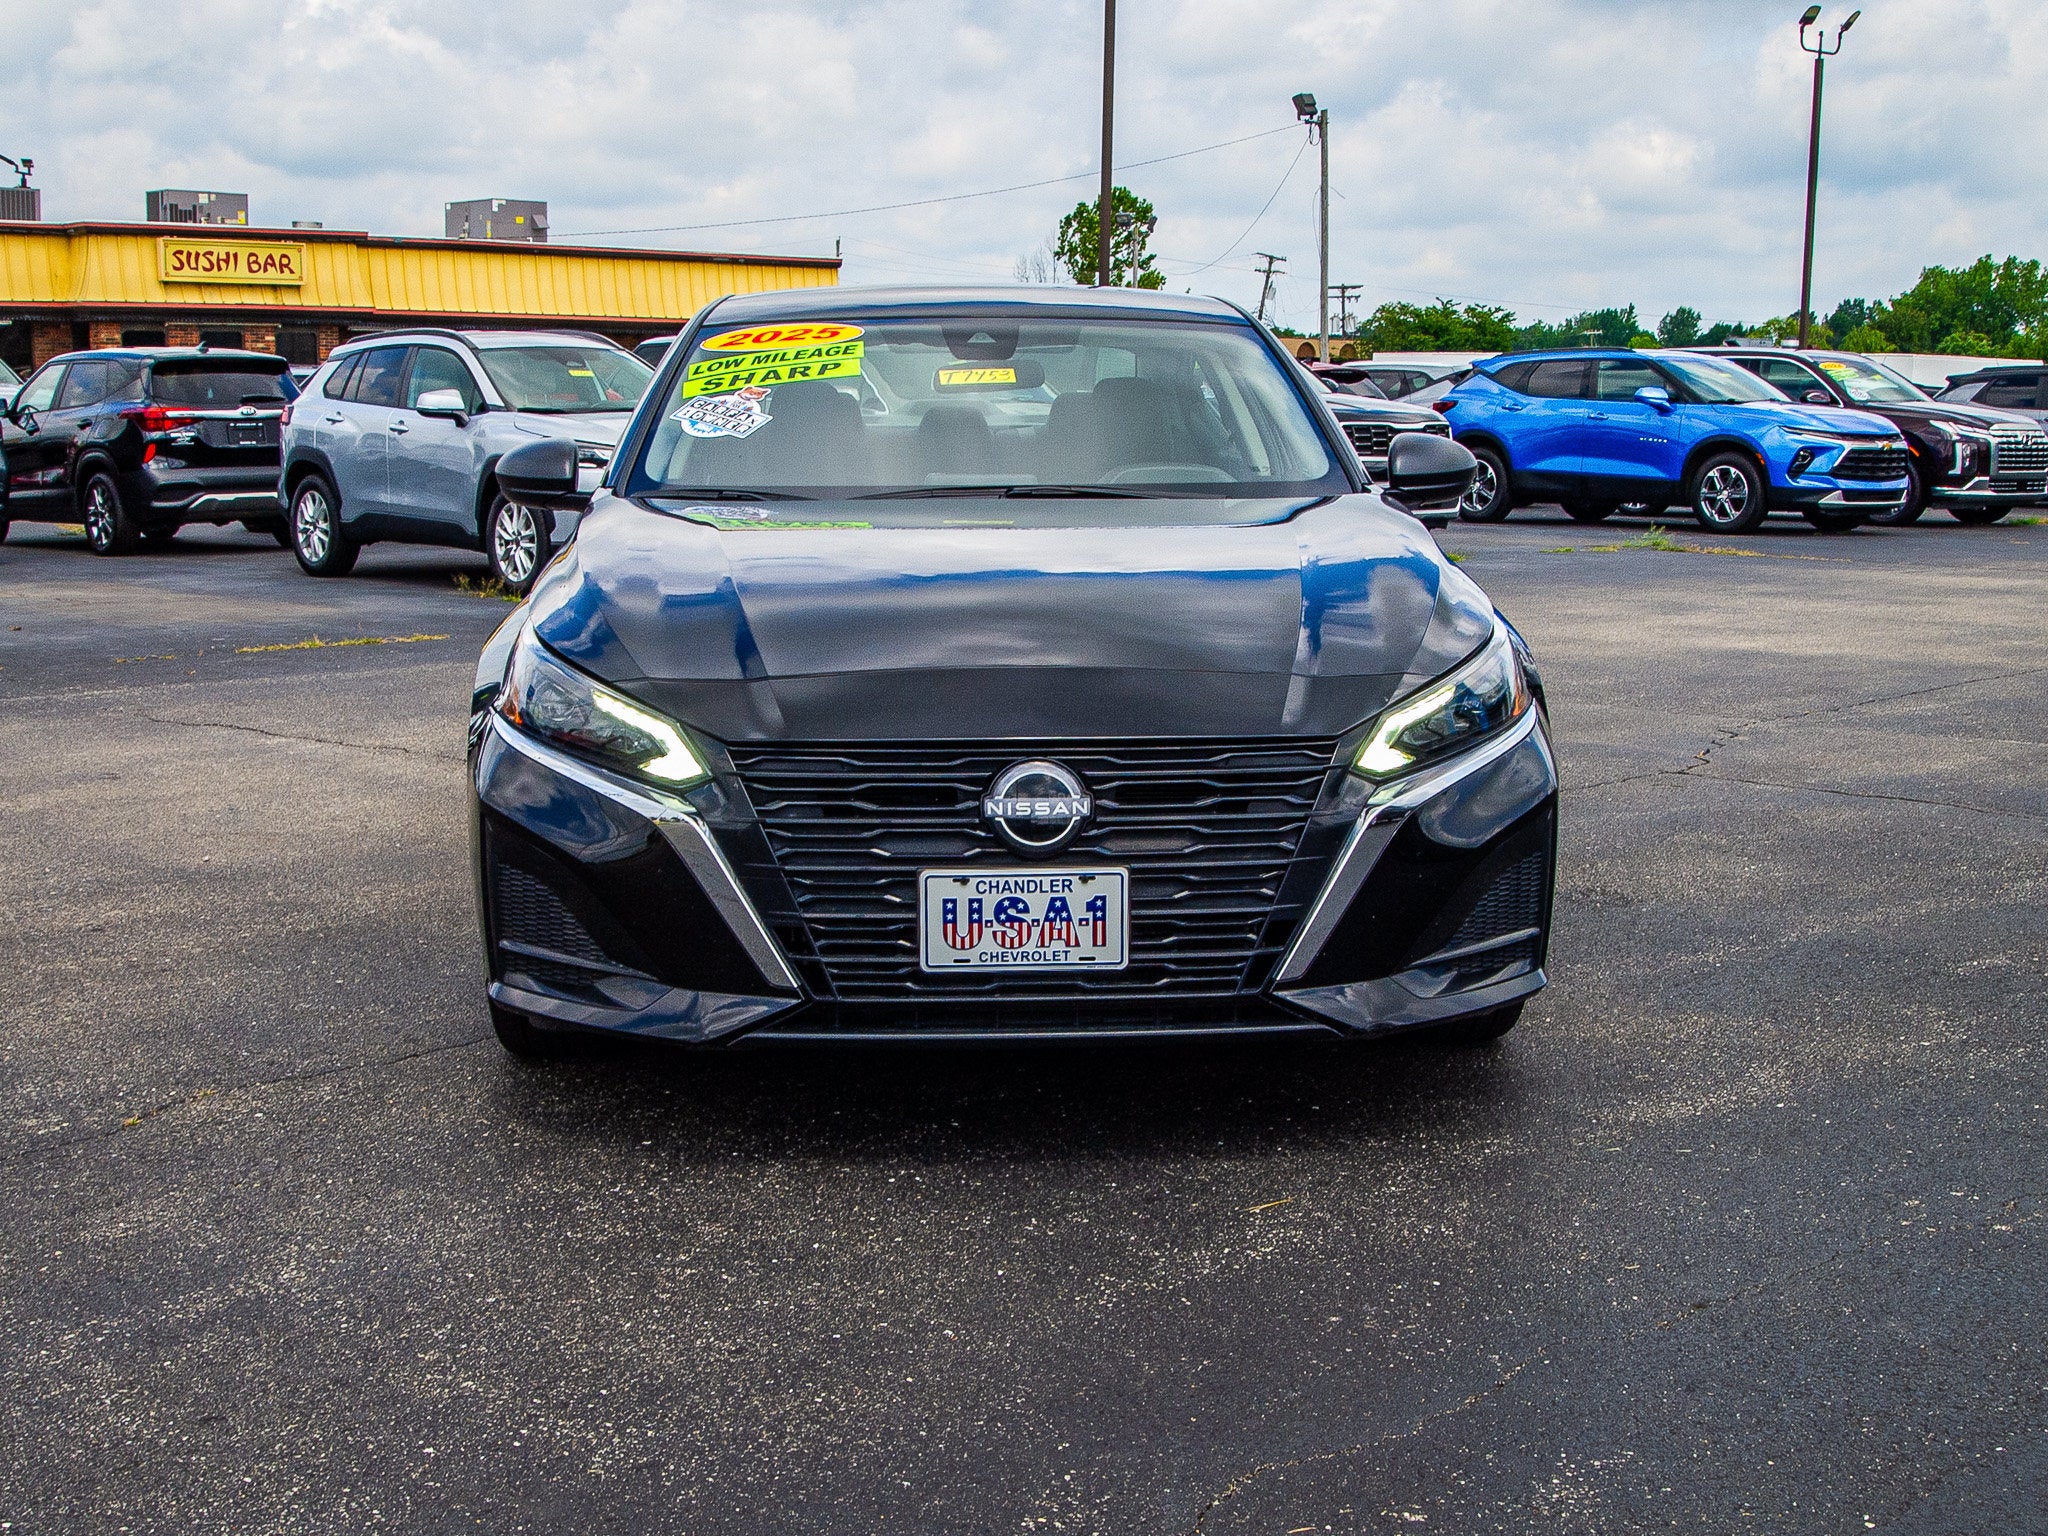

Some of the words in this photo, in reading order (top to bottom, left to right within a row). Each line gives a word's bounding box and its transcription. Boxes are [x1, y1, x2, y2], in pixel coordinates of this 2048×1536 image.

[171, 249, 239, 273] SUSHI
[246, 252, 296, 275] BAR
[718, 327, 846, 349] 2025
[692, 357, 746, 376] LOW
[751, 344, 859, 366] MILEAGE
[700, 362, 842, 392] SHARP
[986, 801, 1090, 816] NISSAN
[975, 878, 1074, 895] CHANDLER
[978, 949, 1071, 963] CHEVROLET
